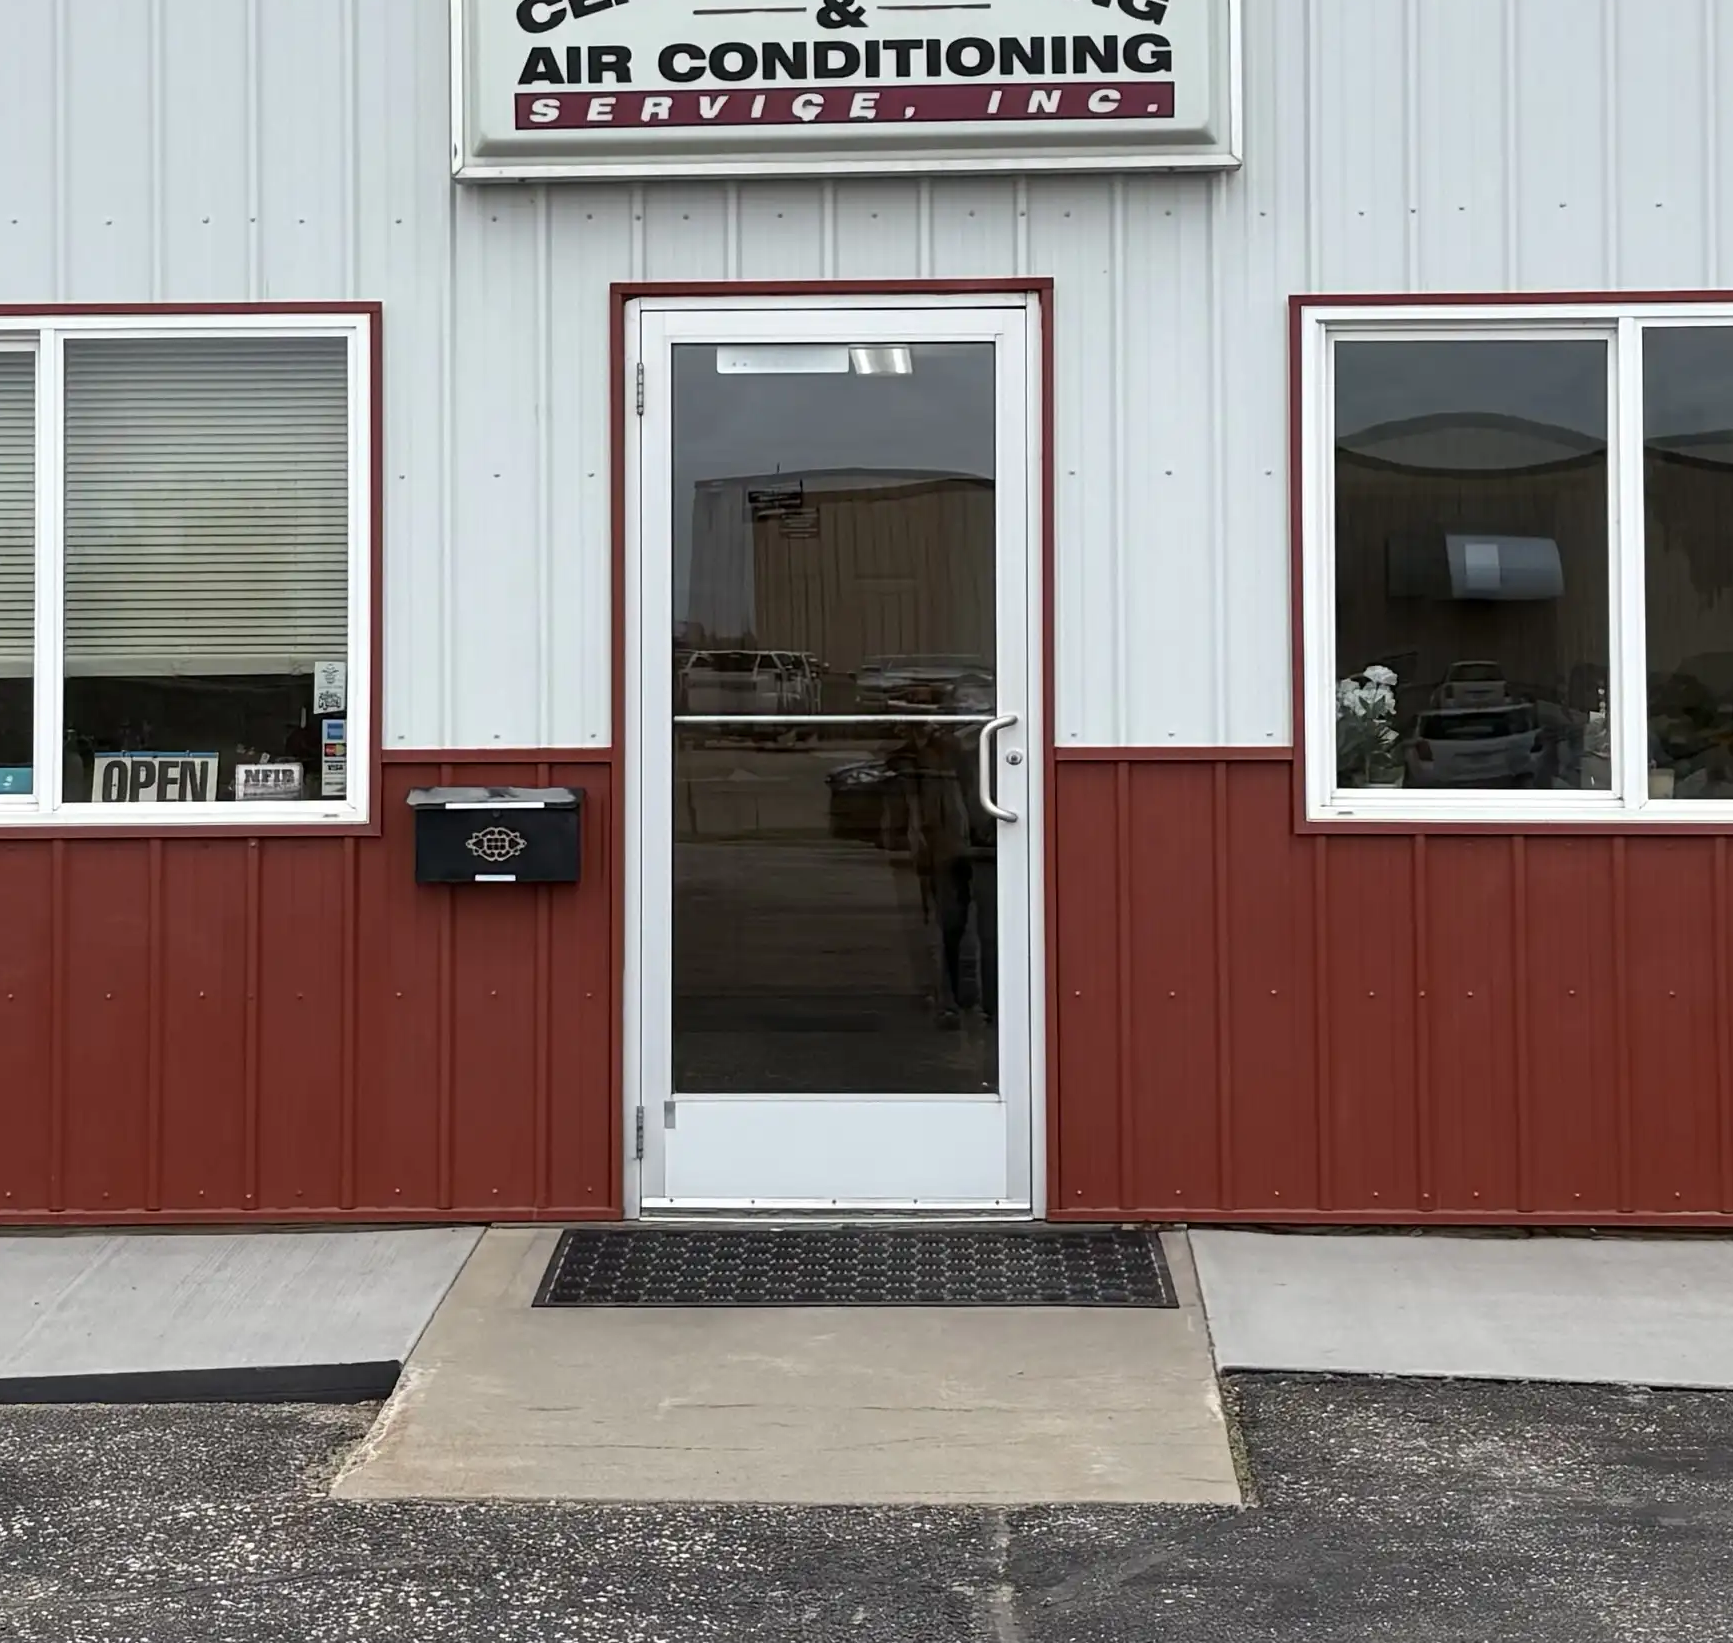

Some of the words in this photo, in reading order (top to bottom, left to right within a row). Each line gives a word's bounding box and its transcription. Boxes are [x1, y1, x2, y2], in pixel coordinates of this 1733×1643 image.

[518, 46, 632, 85] AIR
[658, 33, 1172, 83] CONDITIONING
[528, 92, 916, 123] SERVICE,
[988, 90, 1157, 113] INC.
[102, 760, 209, 802] OPEN
